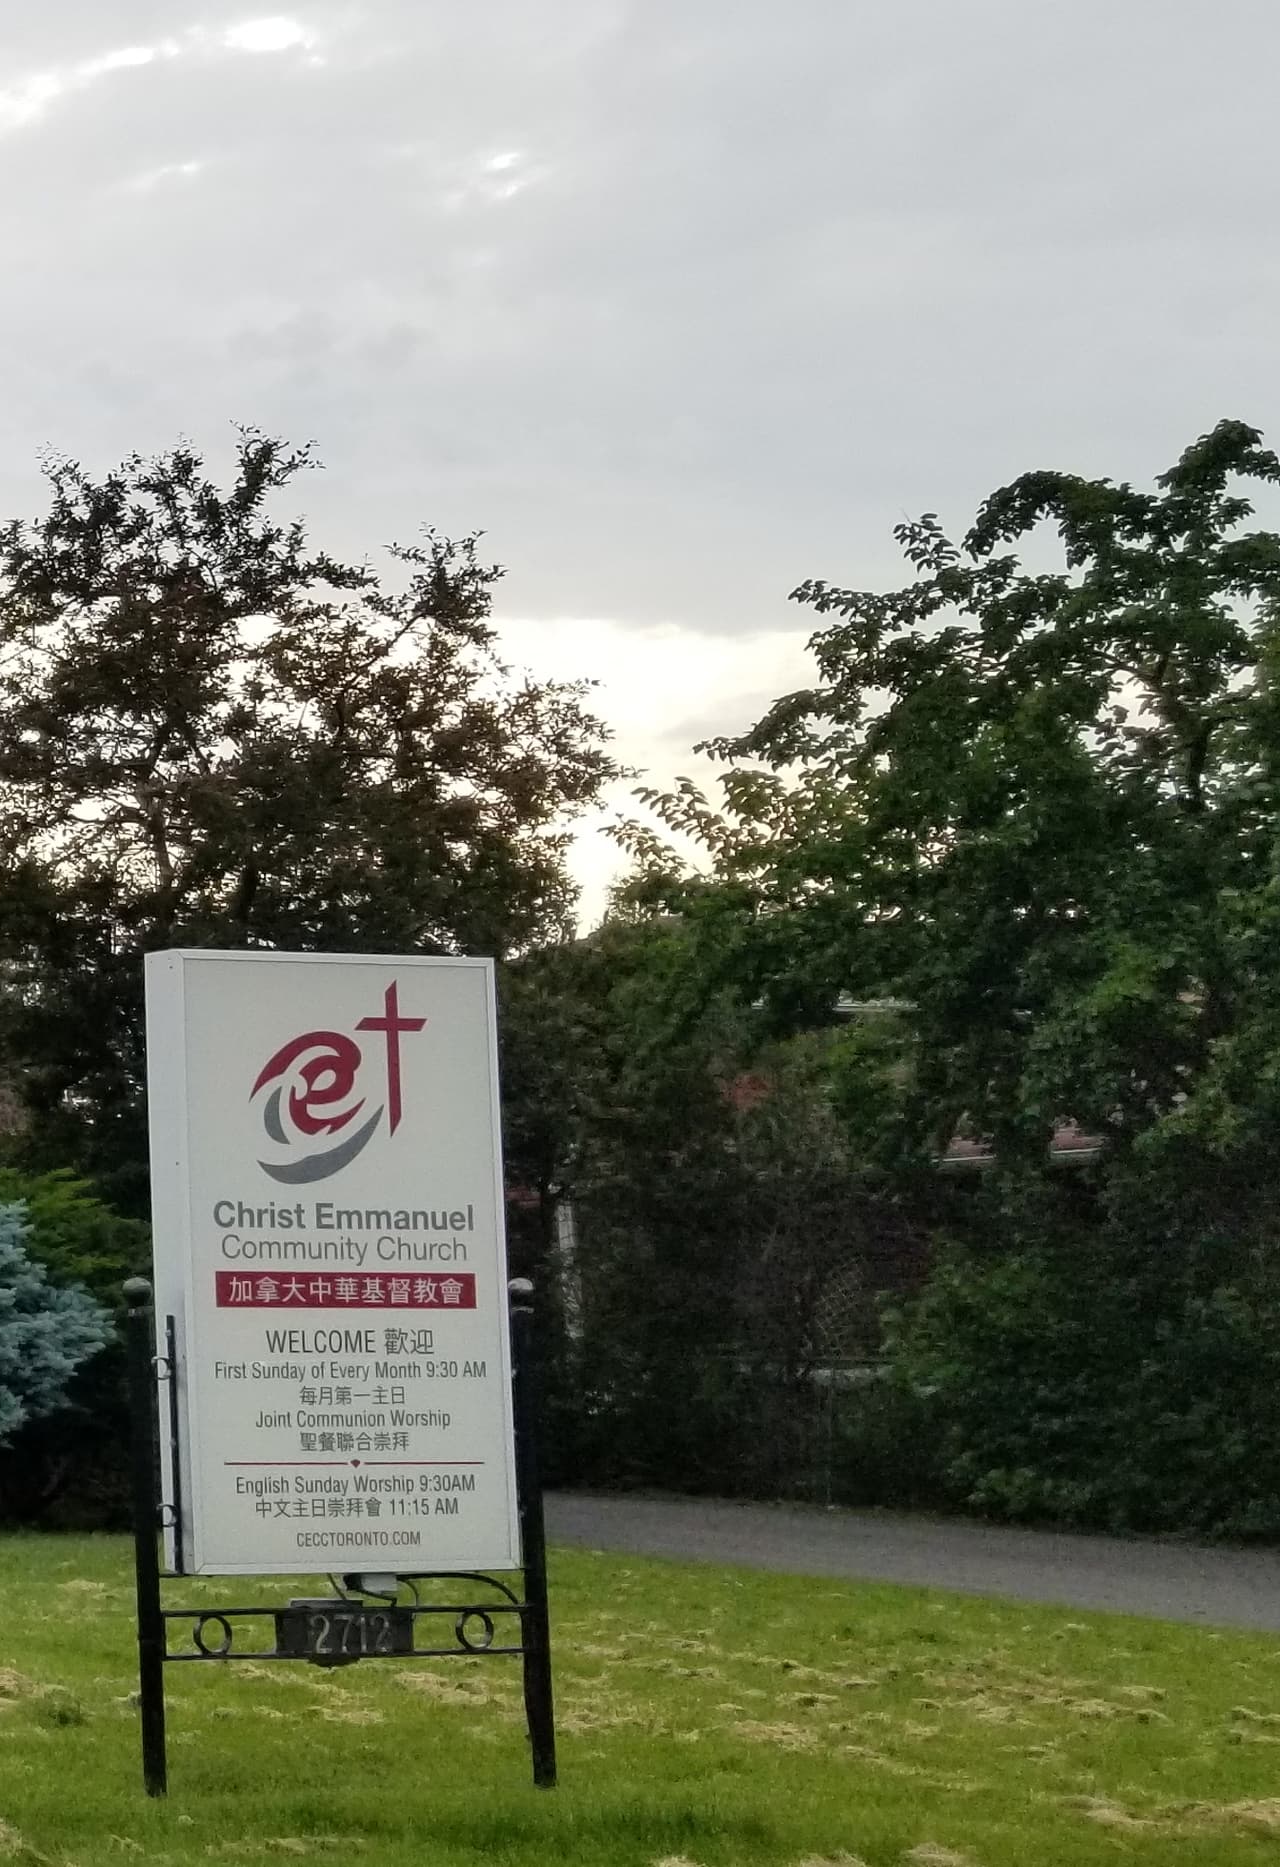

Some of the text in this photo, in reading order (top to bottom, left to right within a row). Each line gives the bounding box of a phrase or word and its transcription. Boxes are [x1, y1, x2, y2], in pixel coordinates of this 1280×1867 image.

[213, 1200, 474, 1232] Christ Emmanuel
[222, 1234, 467, 1266] Community Church
[228, 1277, 464, 1305] 加拿大中華基督教會
[266, 1328, 434, 1355] WELCOME 歡迎
[215, 1361, 487, 1382] First Sunday of Every Month 9:30 AM
[299, 1385, 406, 1405] 每月第一主日
[256, 1410, 450, 1429] Joint Communion Worship
[300, 1432, 410, 1451] 聖餐聯合崇拜
[236, 1474, 475, 1498] English Sunday Worship 9:30AM
[255, 1498, 459, 1518] 中文主日崇拜會 11:15 AM
[296, 1532, 421, 1547] CECCTORONTO.COM
[309, 1614, 393, 1654] 2712
